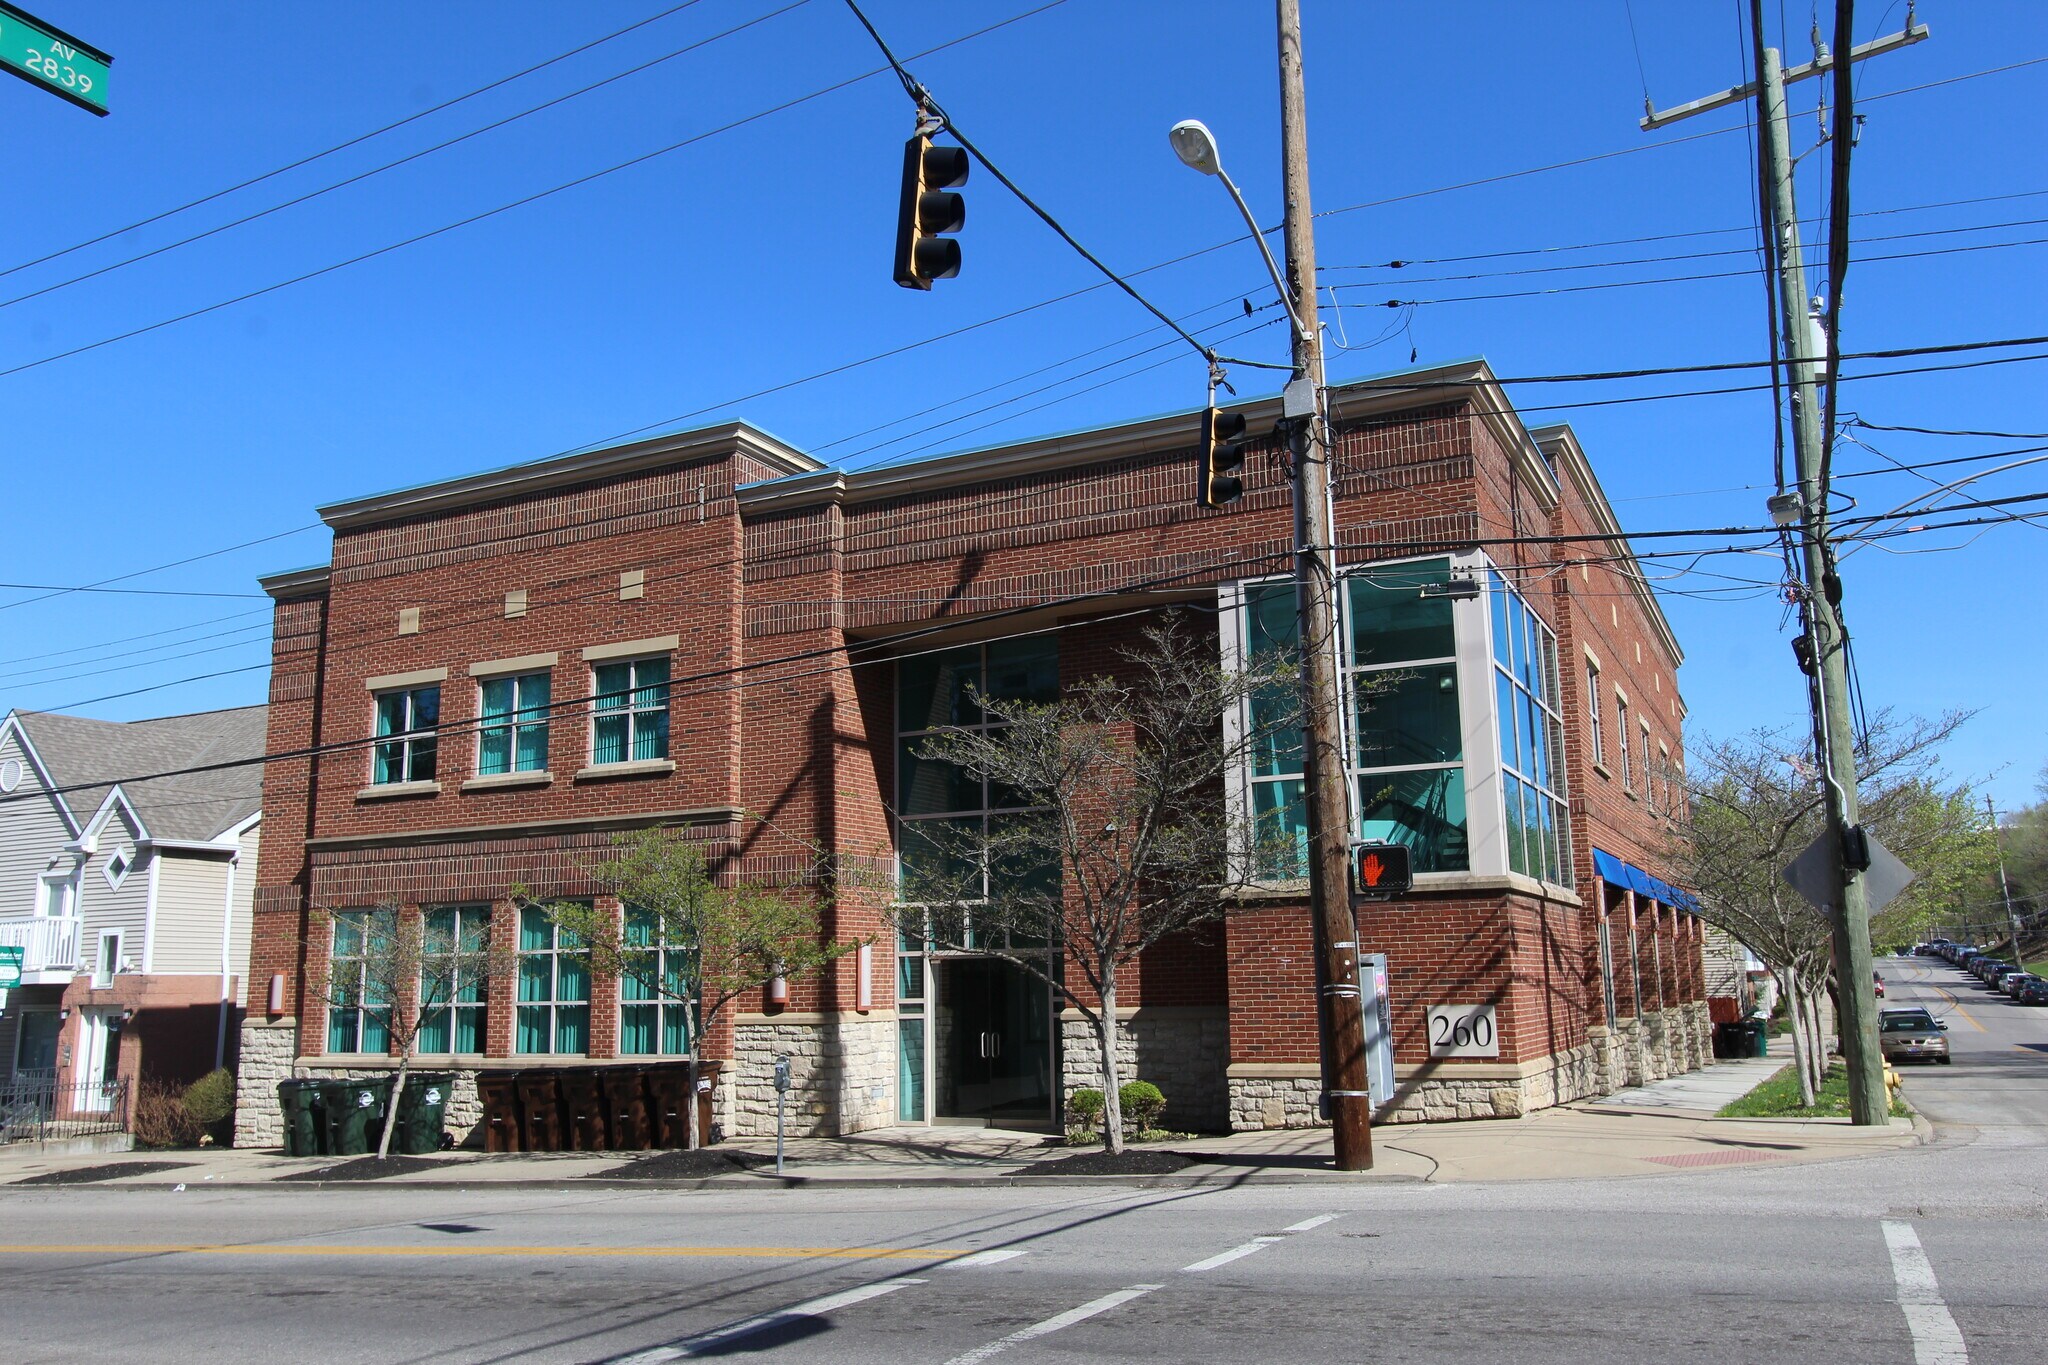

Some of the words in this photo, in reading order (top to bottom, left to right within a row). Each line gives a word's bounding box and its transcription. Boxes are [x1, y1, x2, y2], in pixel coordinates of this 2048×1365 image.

[50, 41, 76, 61] AV
[25, 48, 93, 93] 2839
[1432, 1014, 1492, 1047] 260
